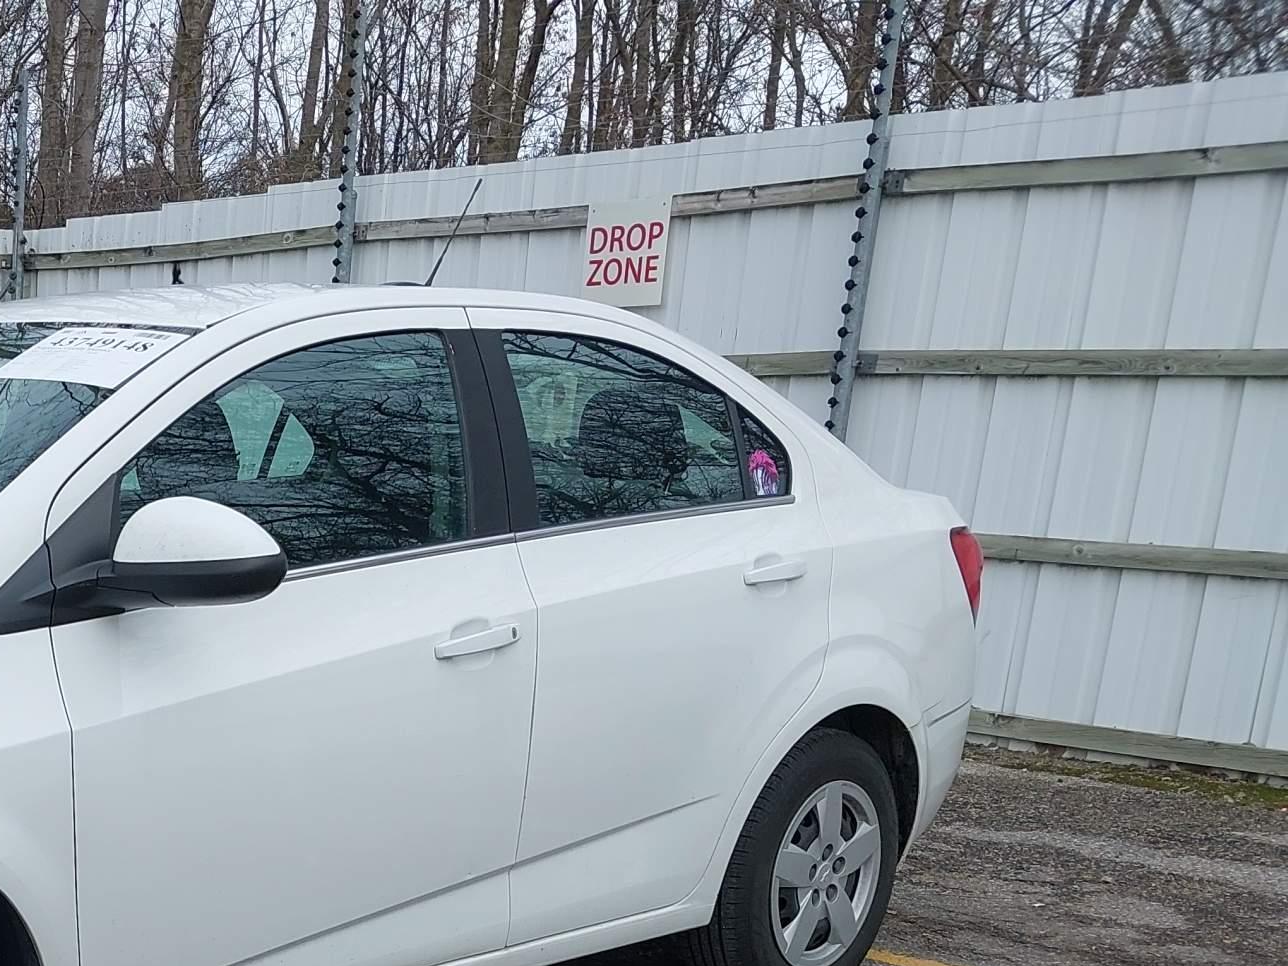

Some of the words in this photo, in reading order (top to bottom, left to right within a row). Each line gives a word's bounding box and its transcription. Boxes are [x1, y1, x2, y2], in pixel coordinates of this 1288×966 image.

[588, 221, 665, 255] DROP
[586, 254, 660, 287] ZONE
[50, 337, 155, 352] 43749148
